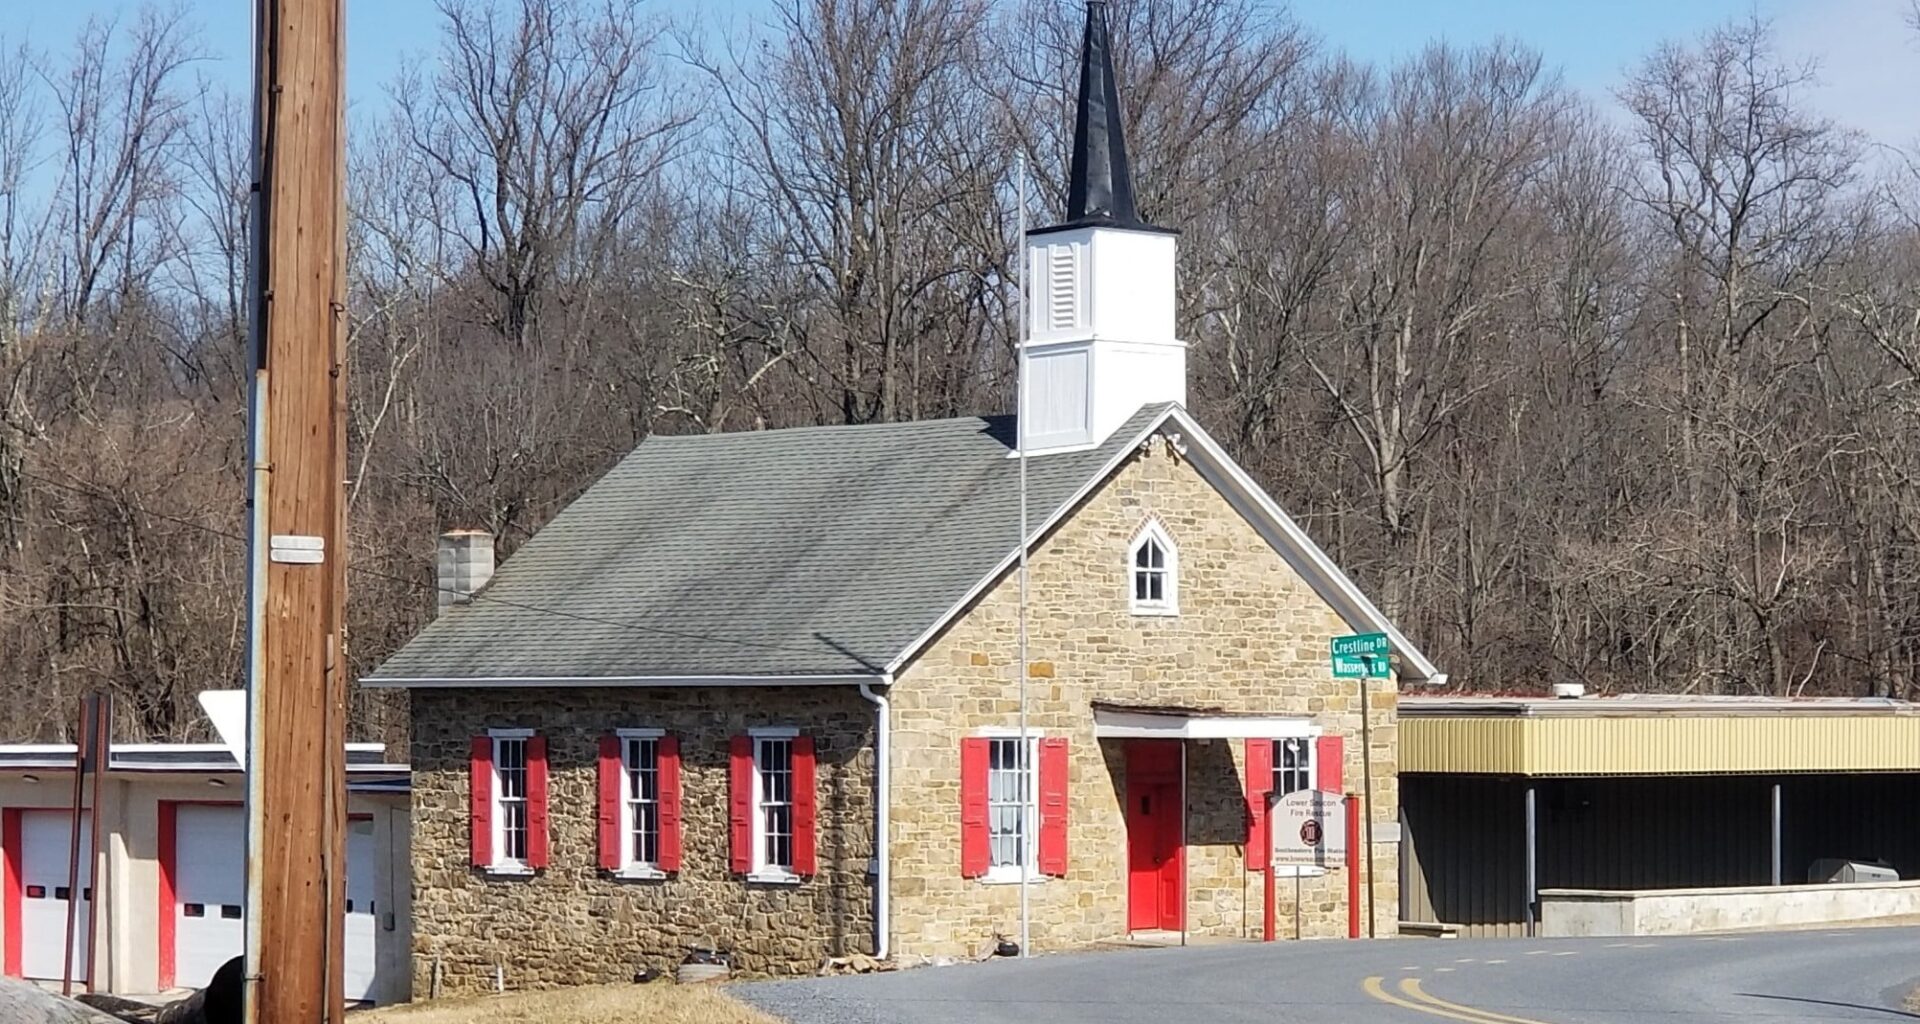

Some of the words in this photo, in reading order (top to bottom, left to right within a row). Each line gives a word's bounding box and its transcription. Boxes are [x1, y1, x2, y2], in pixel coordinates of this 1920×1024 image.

[1332, 639, 1375, 654] Crestline
[1376, 637, 1387, 648] DR
[1309, 799, 1337, 807] Saucon
[1290, 809, 1304, 817] Fire
[1305, 809, 1332, 817] Rescue
